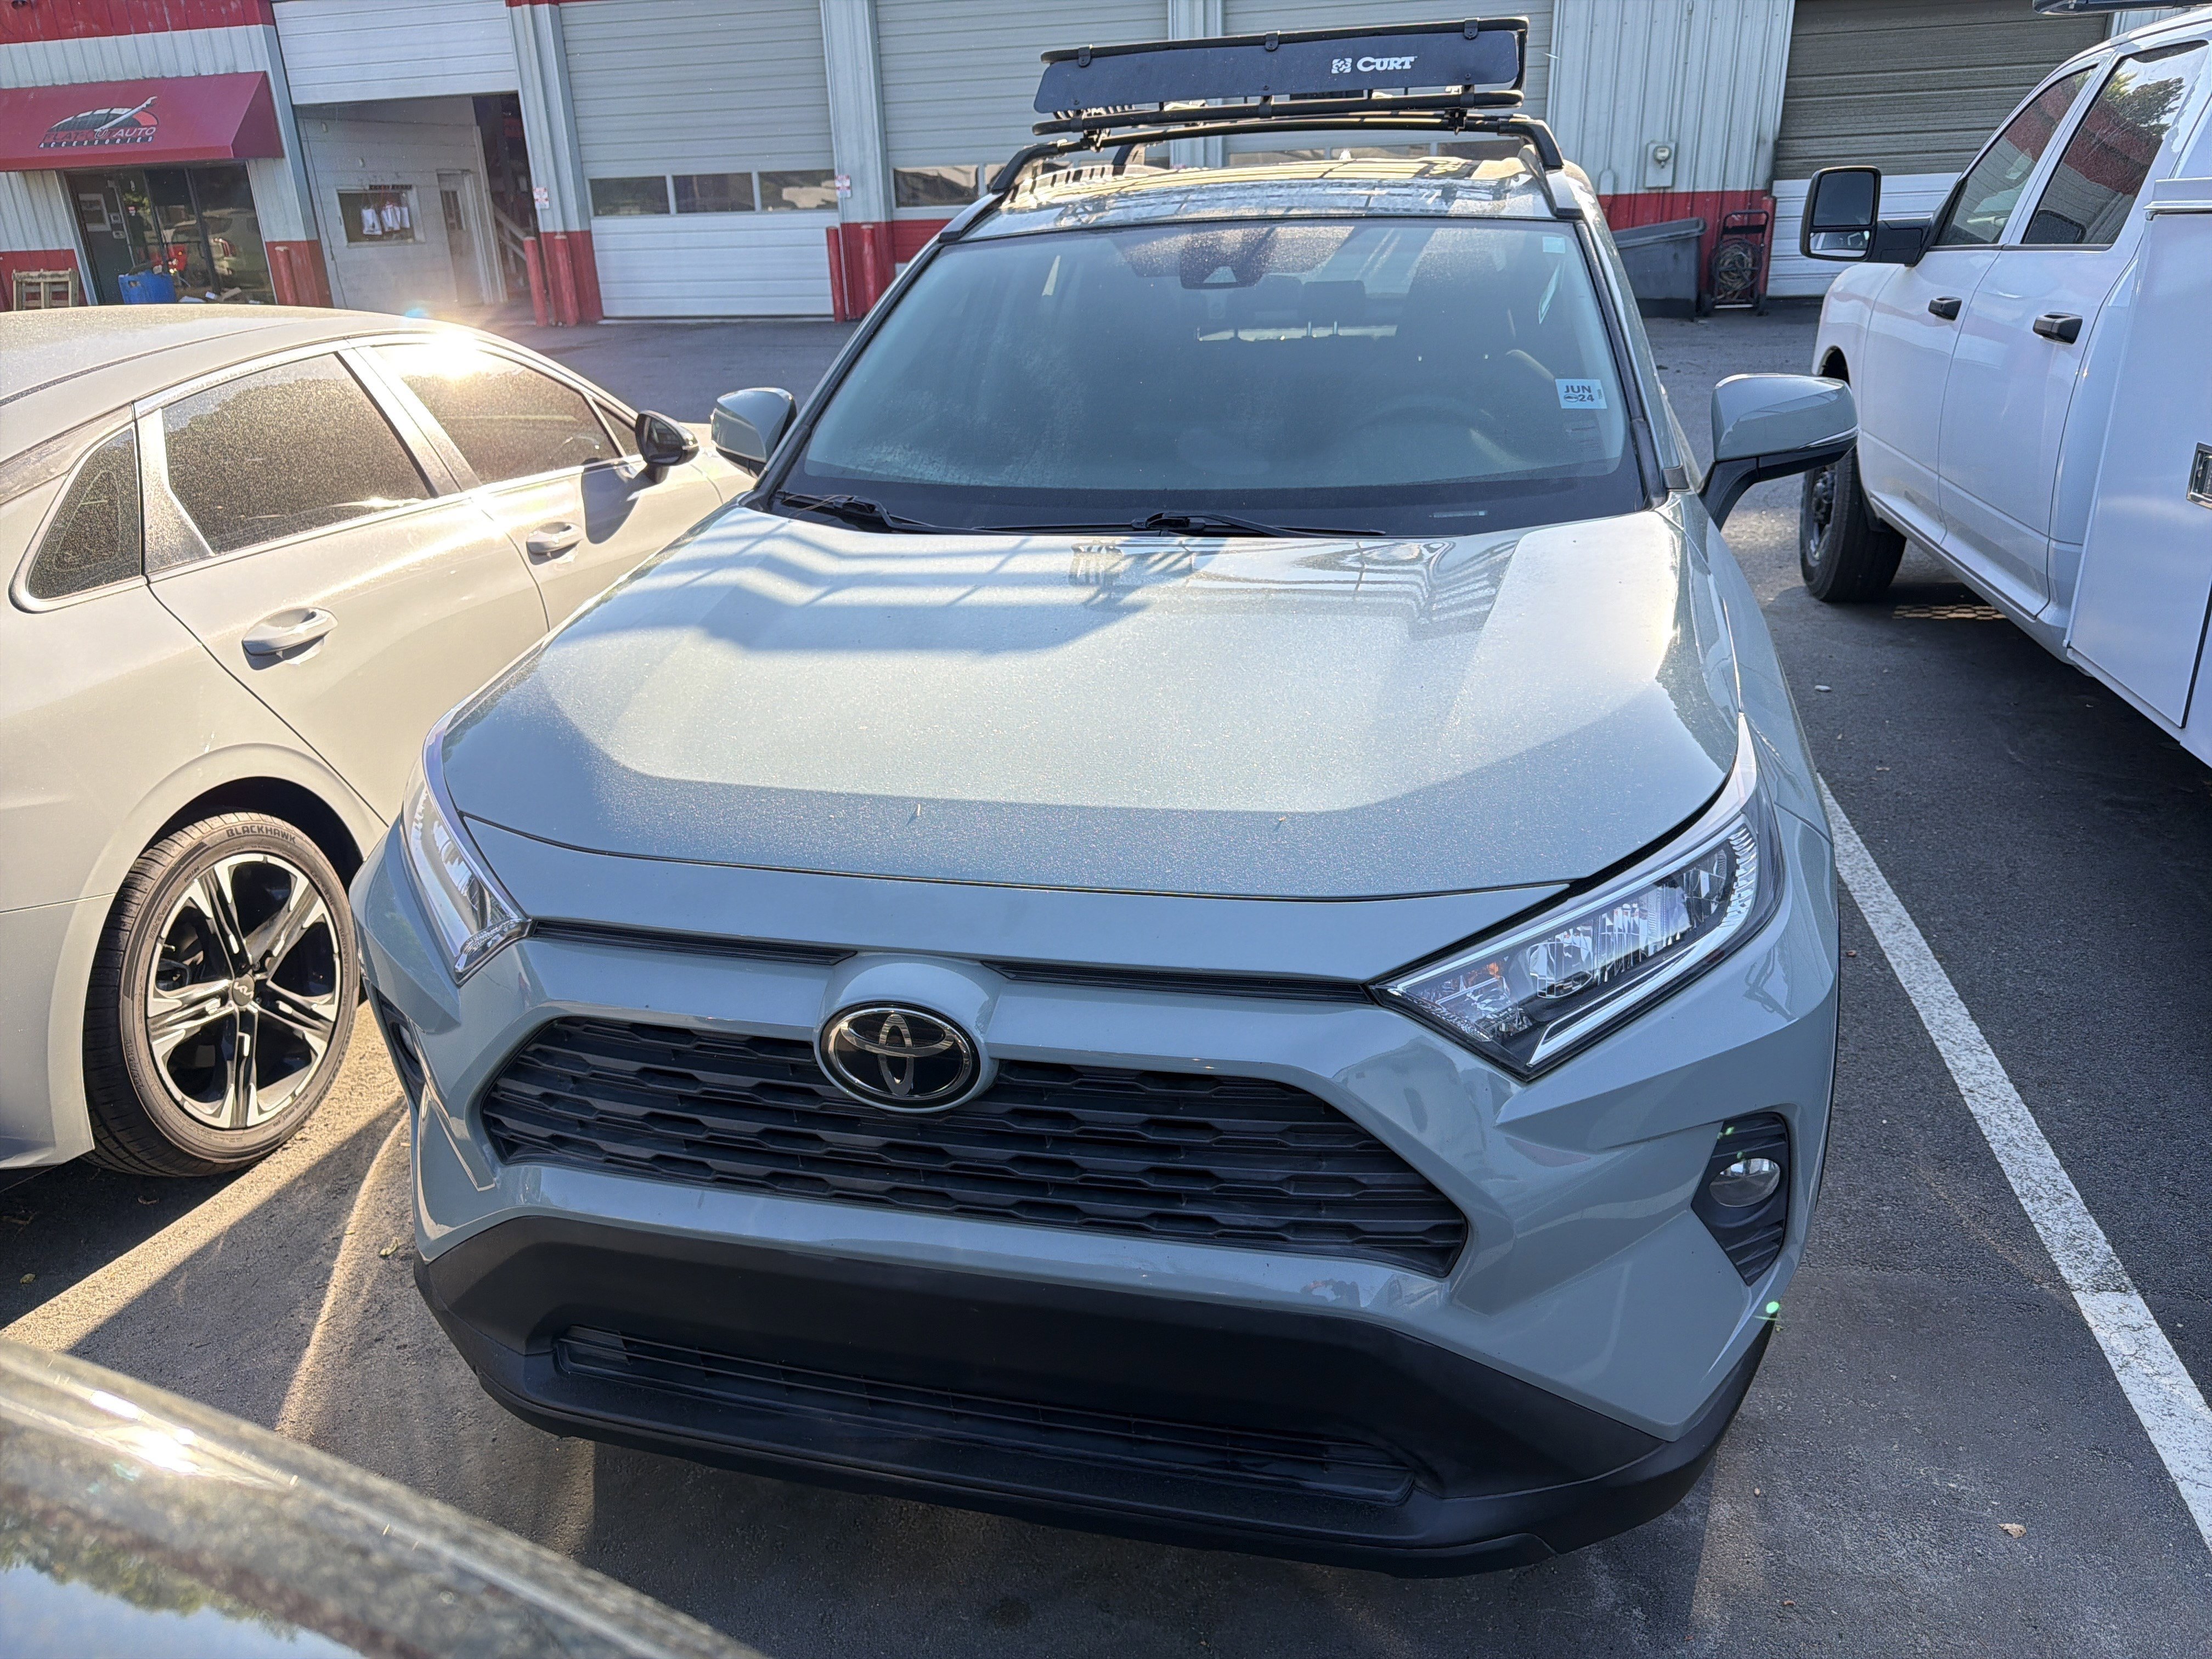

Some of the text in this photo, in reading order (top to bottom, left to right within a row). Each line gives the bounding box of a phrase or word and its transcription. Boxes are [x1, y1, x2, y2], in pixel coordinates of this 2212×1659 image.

[1357, 56, 1415, 72] CURT
[112, 127, 156, 138] AUTO
[39, 136, 153, 148] ACCESSORIES
[1564, 385, 1592, 393] JUN
[1578, 394, 1595, 402] 24
[225, 825, 296, 844] BLACKHAWK
